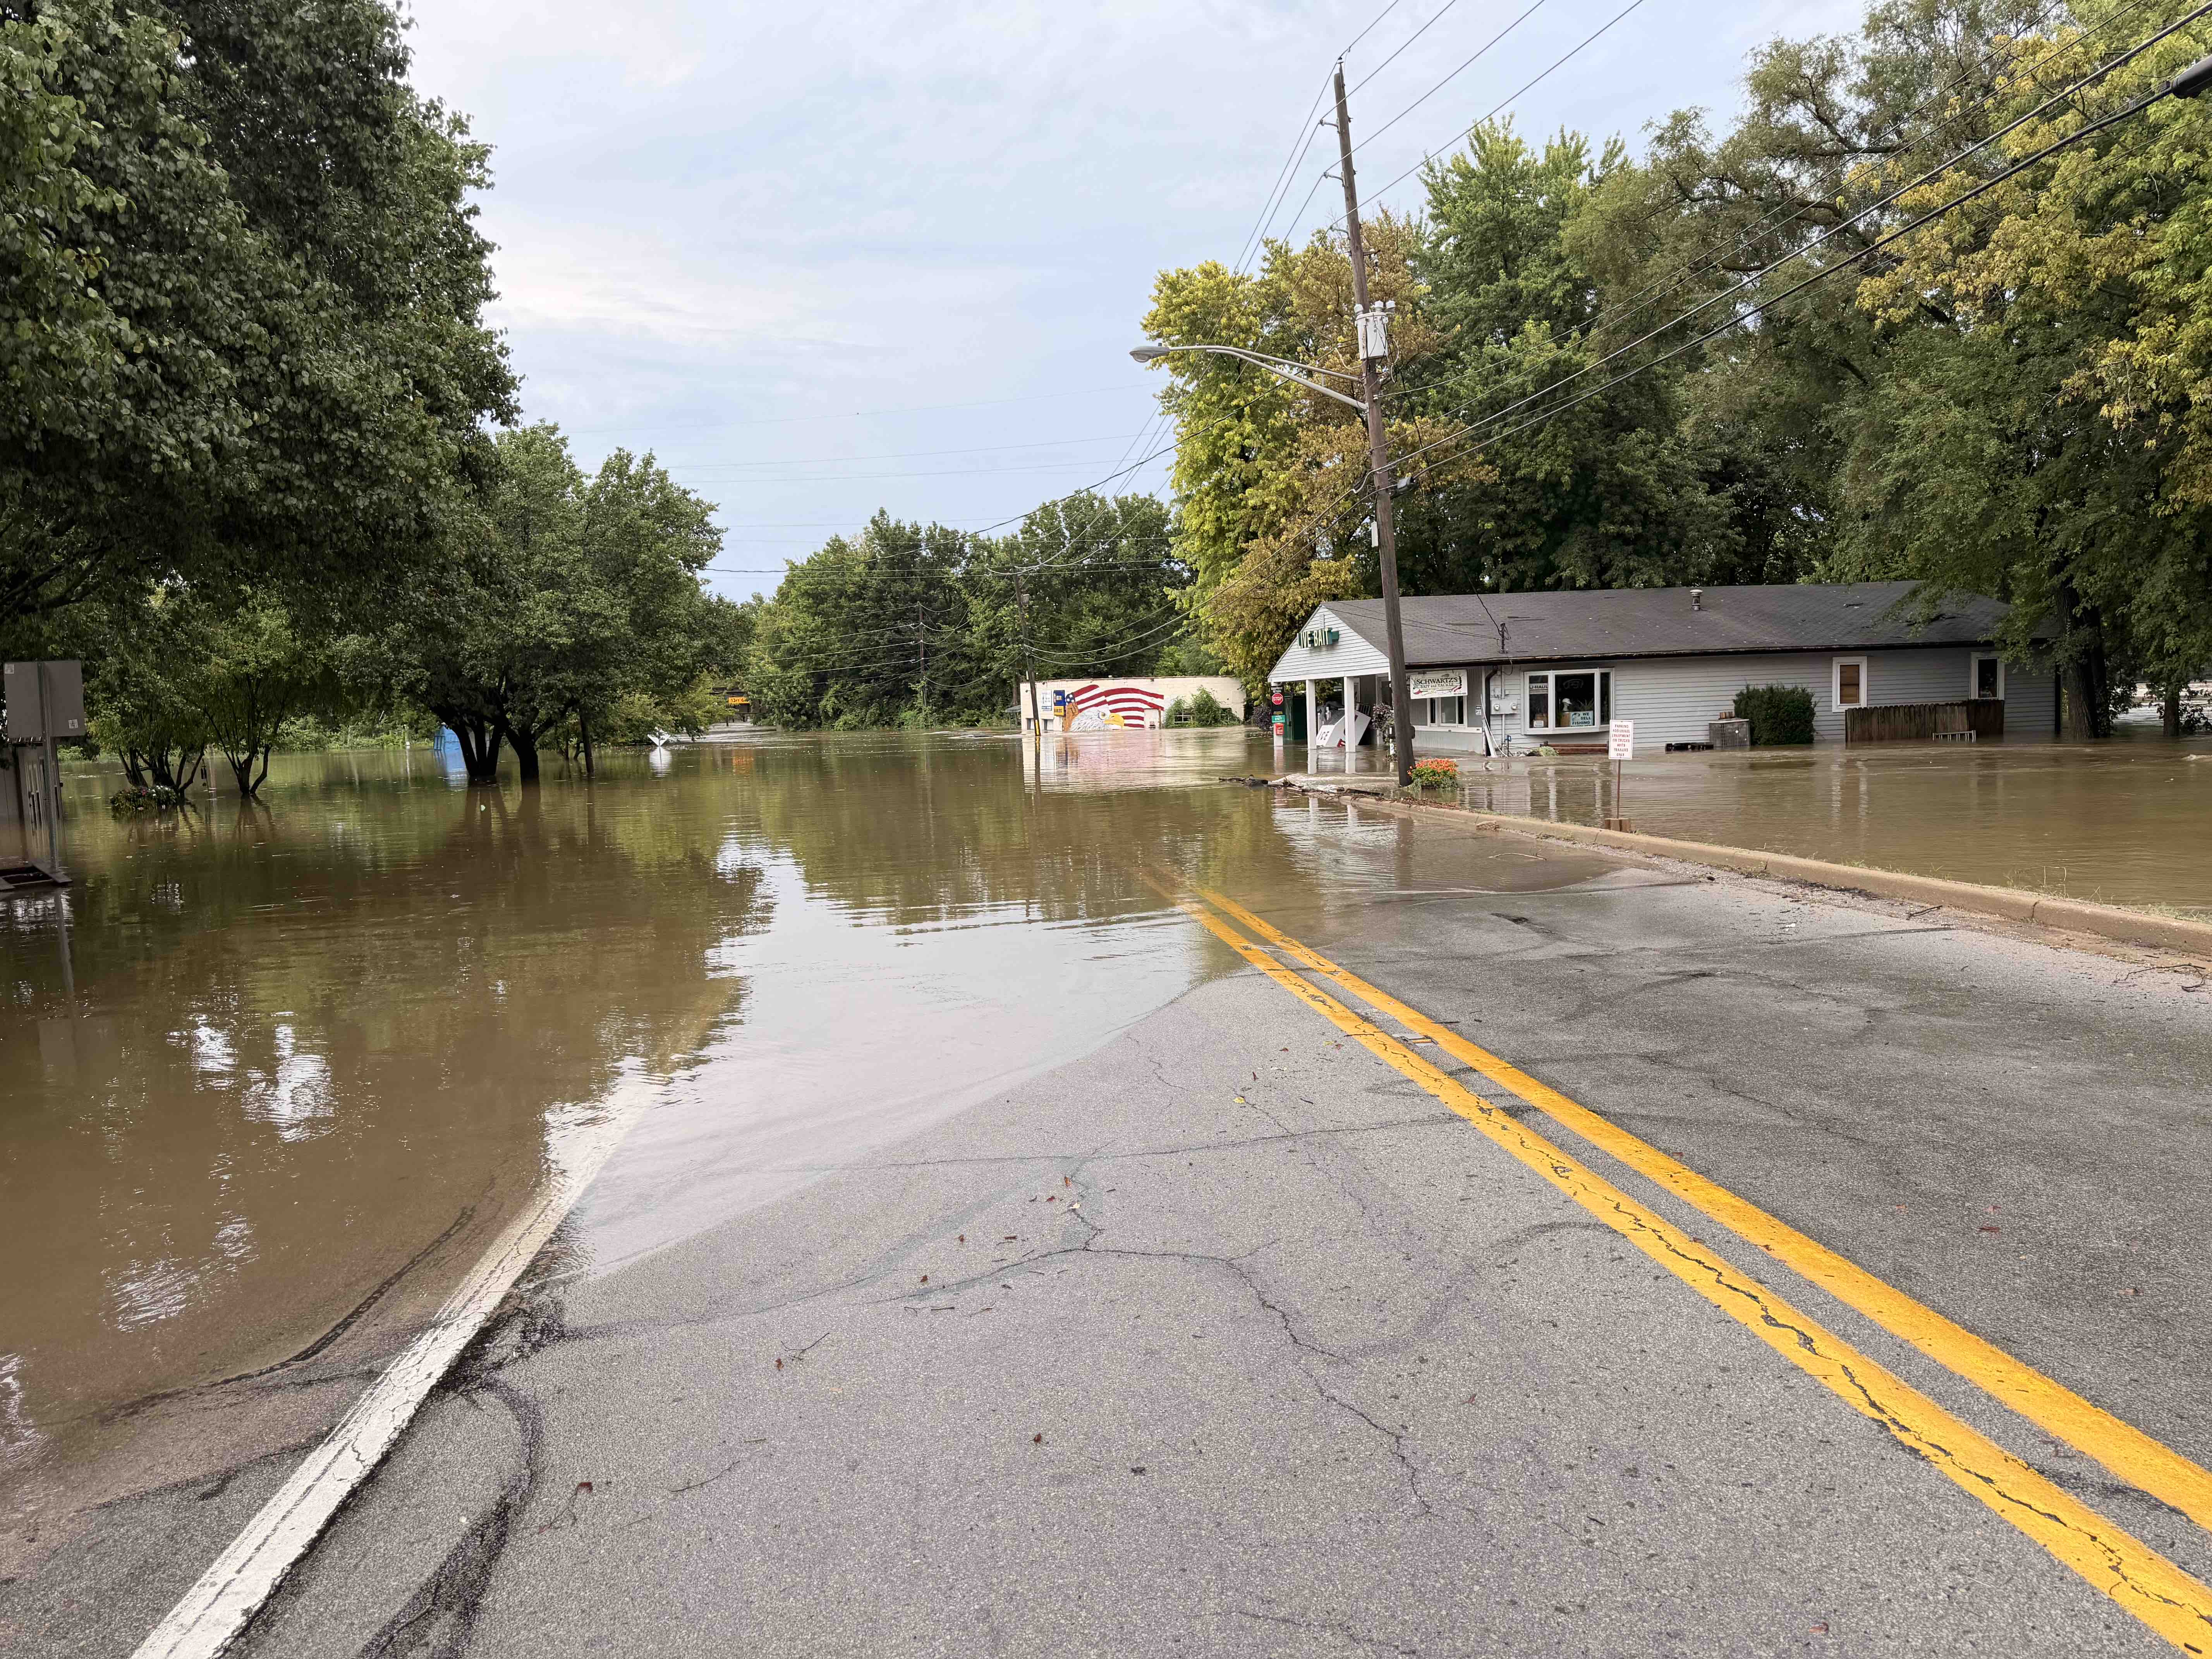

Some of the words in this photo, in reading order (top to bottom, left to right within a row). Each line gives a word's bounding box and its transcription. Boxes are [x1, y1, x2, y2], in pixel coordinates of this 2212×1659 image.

[1297, 631, 1311, 649] LIVE
[1313, 627, 1328, 647] BAIT
[1317, 731, 1329, 740] ICE
